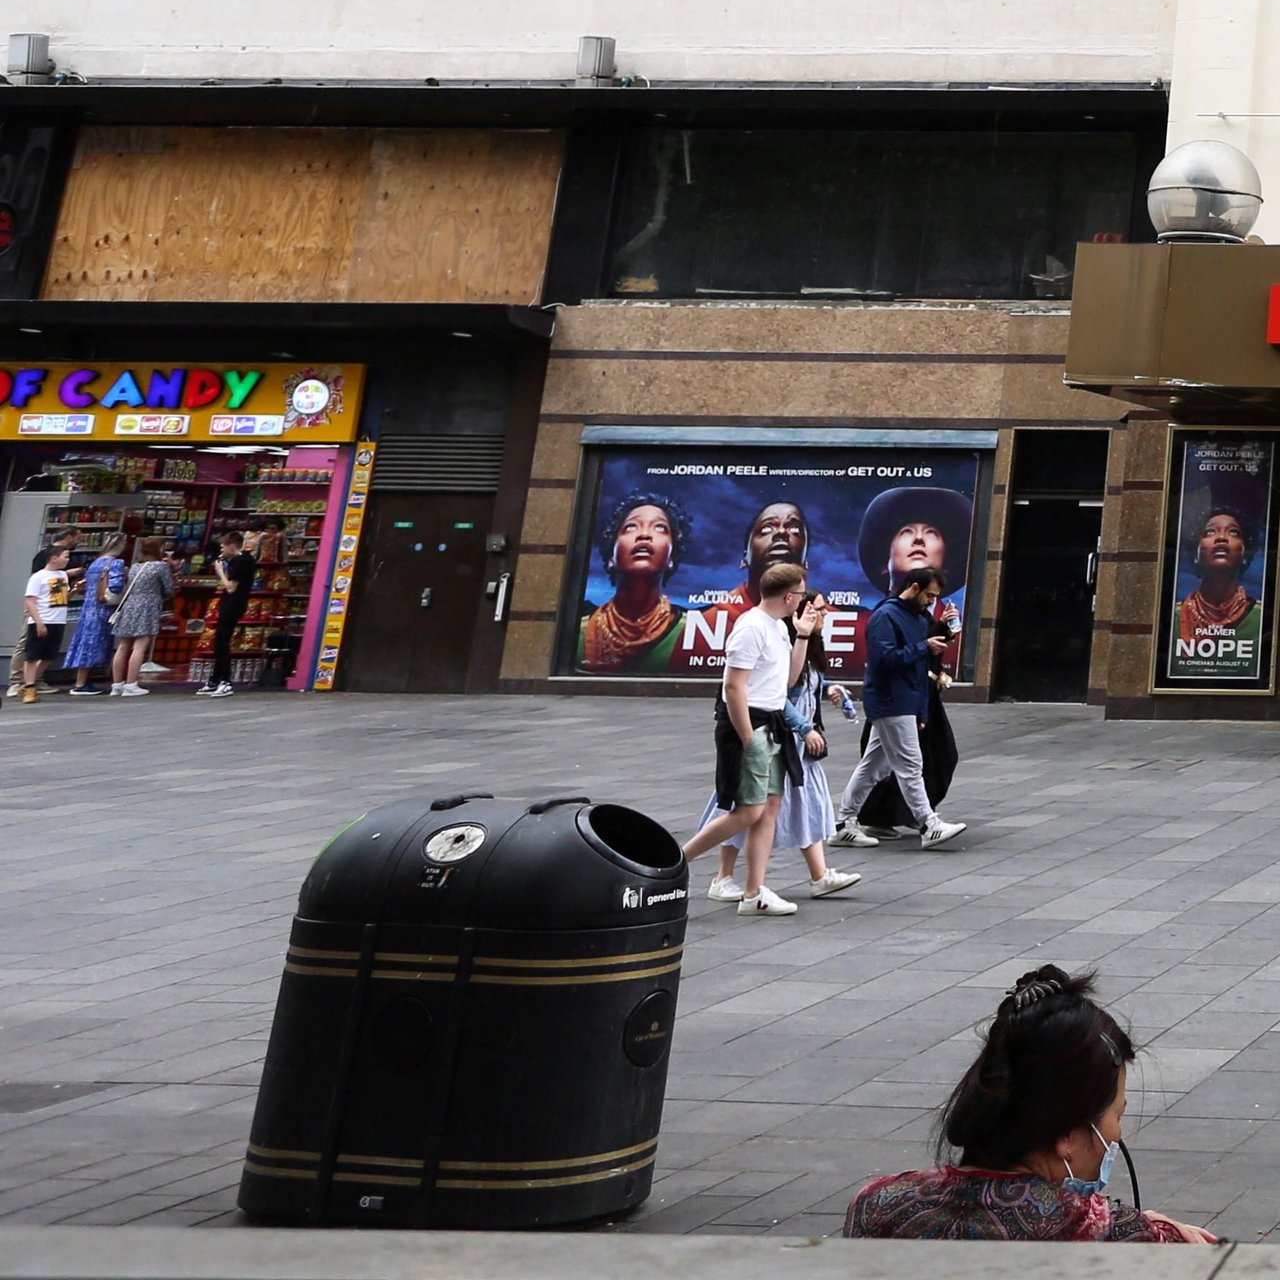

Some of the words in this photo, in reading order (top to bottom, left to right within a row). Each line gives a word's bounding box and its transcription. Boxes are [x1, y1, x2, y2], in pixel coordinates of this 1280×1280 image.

[58, 368, 265, 410] CANDY
[1194, 450, 1233, 458] JORDAN
[1235, 450, 1265, 459] PEELE
[647, 467, 669, 475] FROM
[669, 464, 724, 475] JORDAN
[726, 465, 767, 475] PEELE
[847, 467, 874, 477] GET
[876, 467, 905, 477] OUT
[913, 467, 932, 478] US
[1199, 463, 1218, 471] GET
[1219, 464, 1239, 472] OUT
[688, 594, 744, 605] KALUUYA
[827, 595, 860, 606] YEUN
[682, 609, 859, 652] NE
[1195, 628, 1236, 636] PALMER
[1175, 638, 1254, 659] NOPE
[689, 656, 704, 666] IN
[828, 657, 843, 668] 12
[647, 889, 676, 906] general
